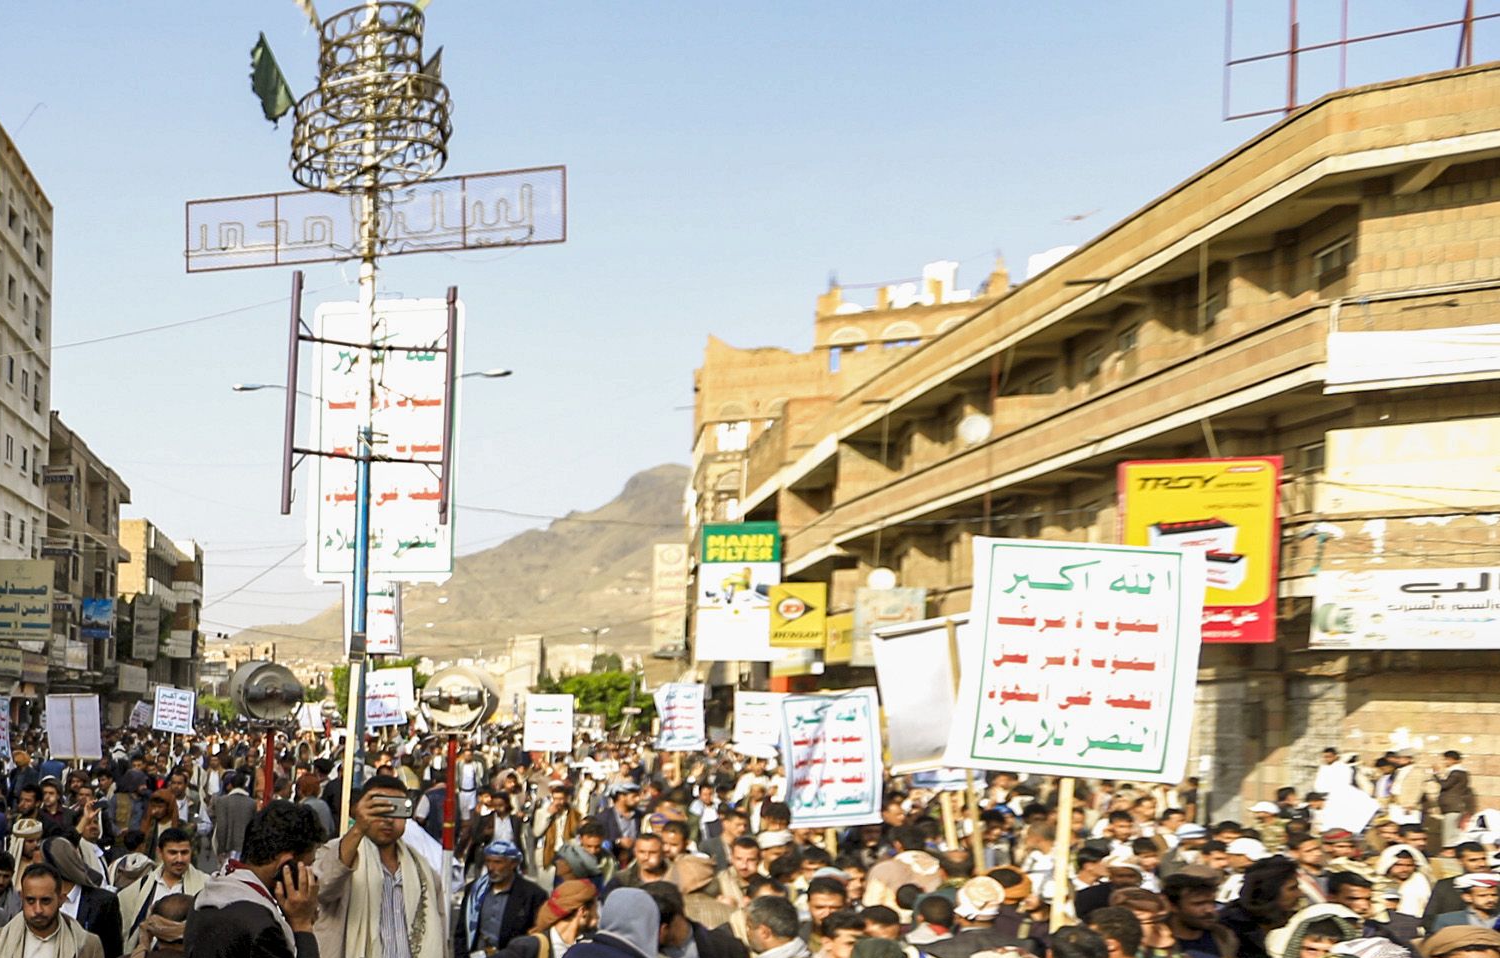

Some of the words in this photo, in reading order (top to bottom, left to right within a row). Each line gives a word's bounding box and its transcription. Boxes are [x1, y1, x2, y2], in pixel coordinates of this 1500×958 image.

[706, 533, 774, 547] MANN
[706, 546, 773, 561] FILTER
[1106, 563, 1172, 596] الله
[772, 630, 823, 640] DUNLOP
[1075, 718, 1159, 758] النصر
